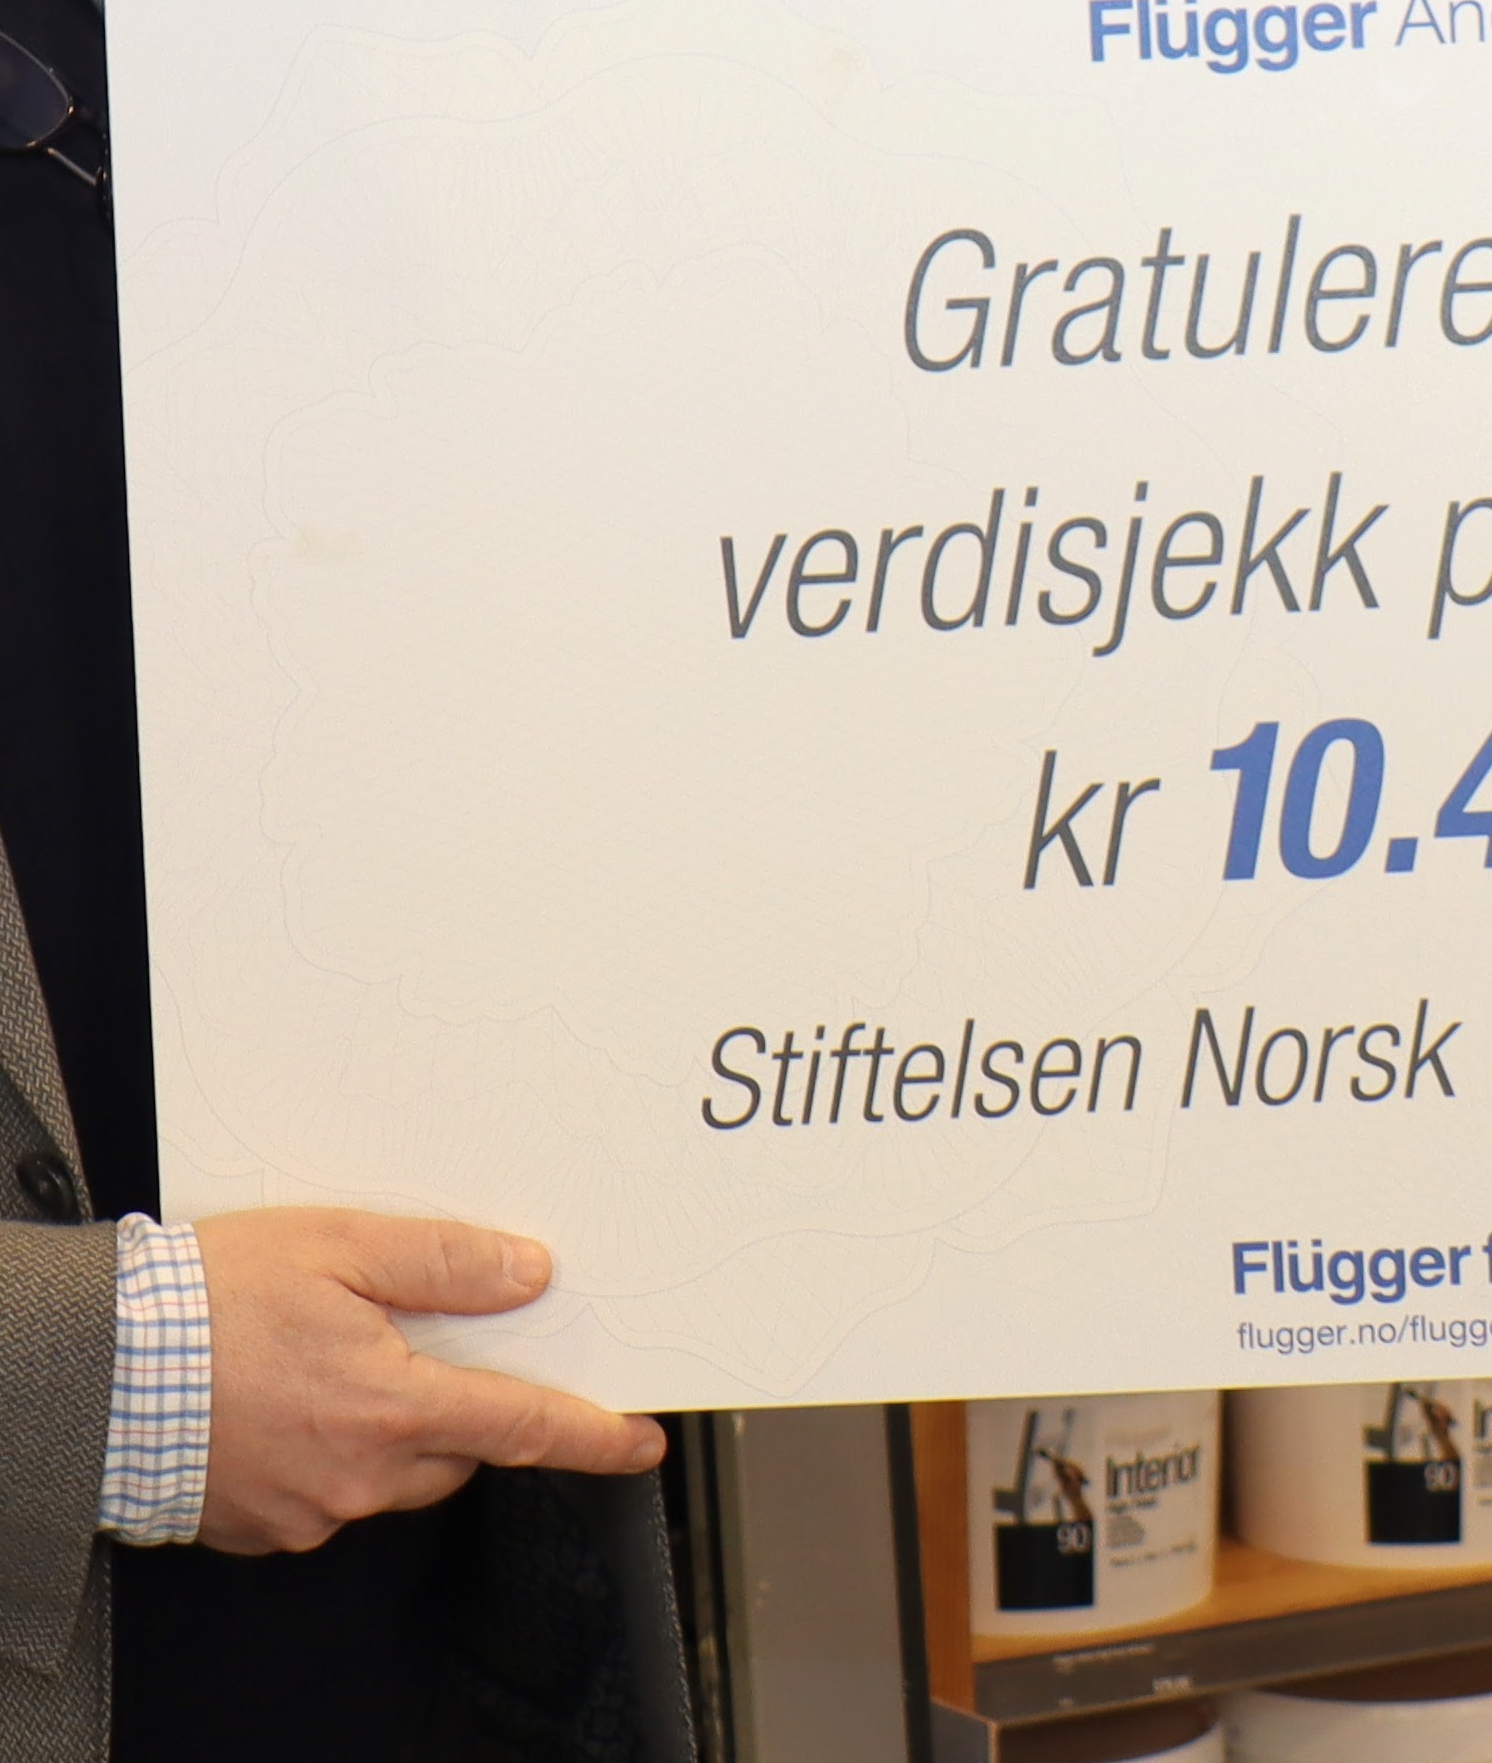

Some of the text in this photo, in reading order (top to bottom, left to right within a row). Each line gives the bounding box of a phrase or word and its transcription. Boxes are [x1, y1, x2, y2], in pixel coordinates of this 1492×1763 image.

[717, 468, 1390, 660] verdisjekk
[1021, 748, 1162, 891] kr
[699, 1015, 1146, 1132] Stiftelsen
[1179, 995, 1463, 1111] Norsk
[1230, 1237, 1472, 1307] Flügger
[1106, 1442, 1203, 1497] Interior
[1424, 1461, 1458, 1493] 90
[1057, 1522, 1090, 1555] 90
